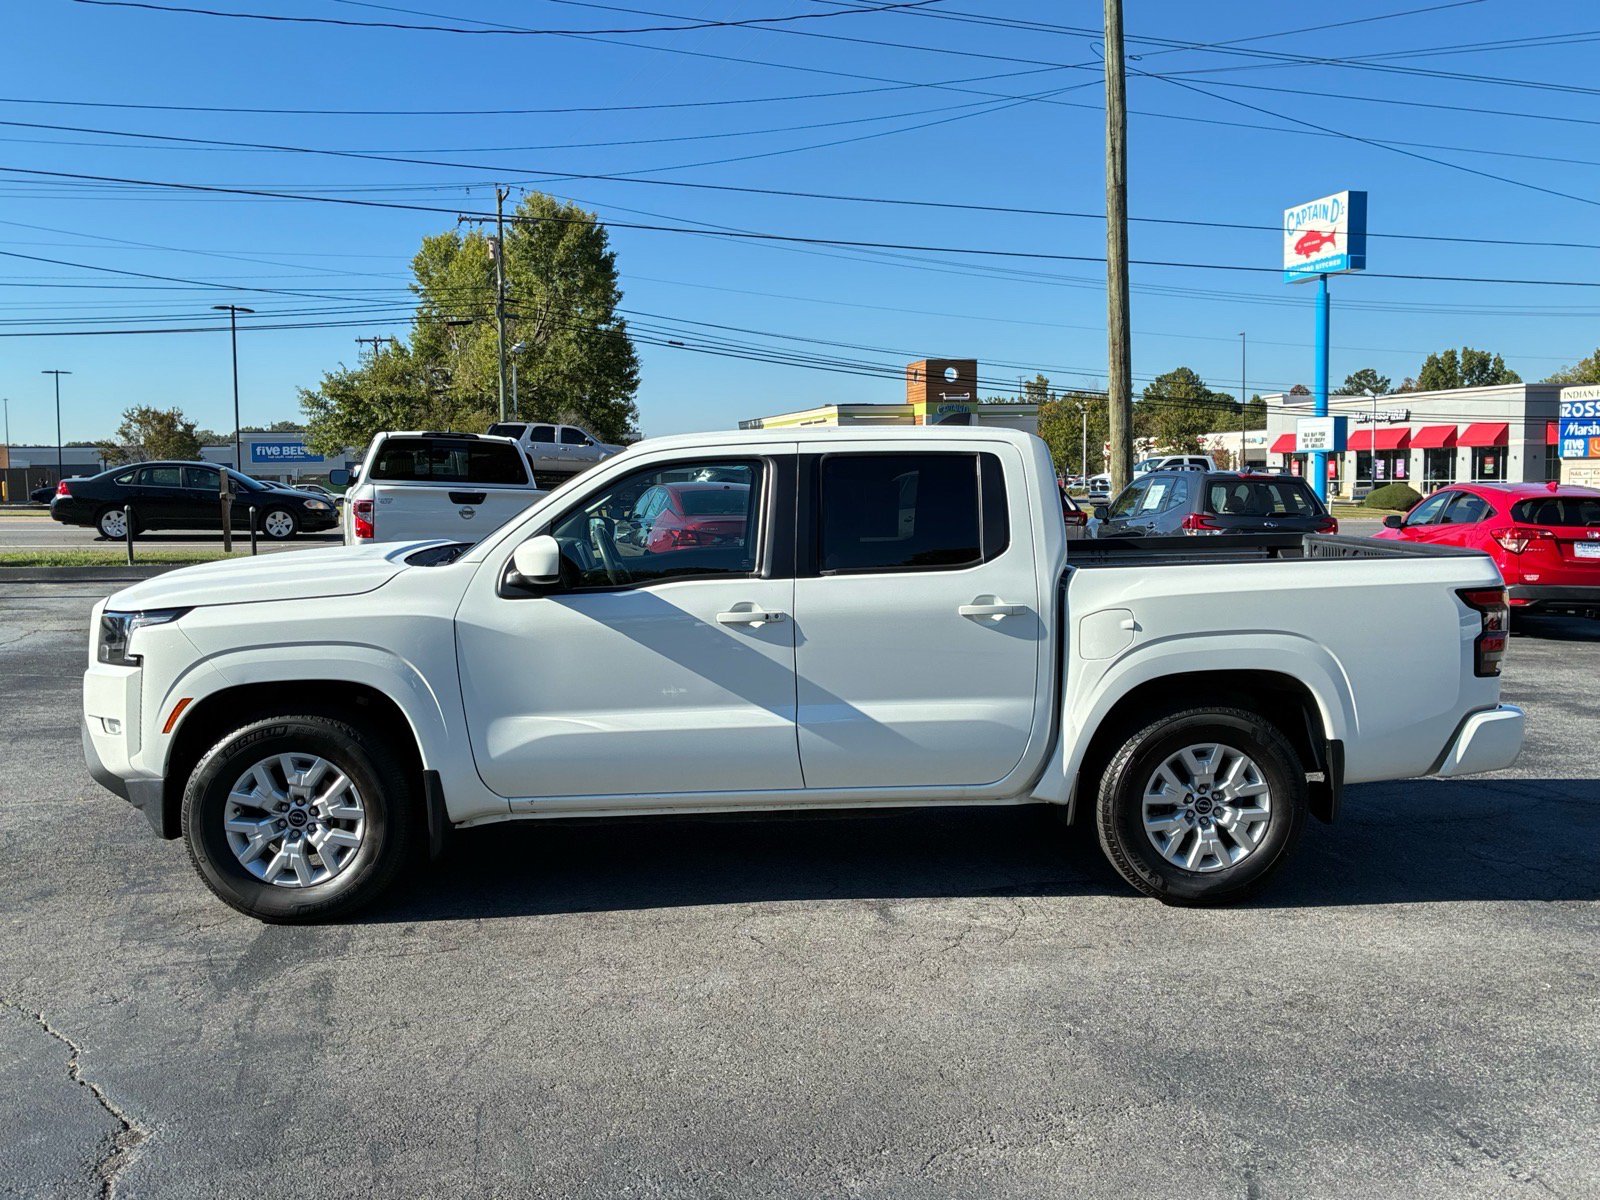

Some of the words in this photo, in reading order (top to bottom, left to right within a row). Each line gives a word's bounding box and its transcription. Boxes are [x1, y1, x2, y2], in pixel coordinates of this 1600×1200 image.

[1287, 204, 1329, 236] CAPTAIN
[1564, 390, 1593, 399] INDIAN
[1564, 439, 1584, 450] five
[256, 446, 280, 456] five
[224, 725, 287, 756] MICHELIN
